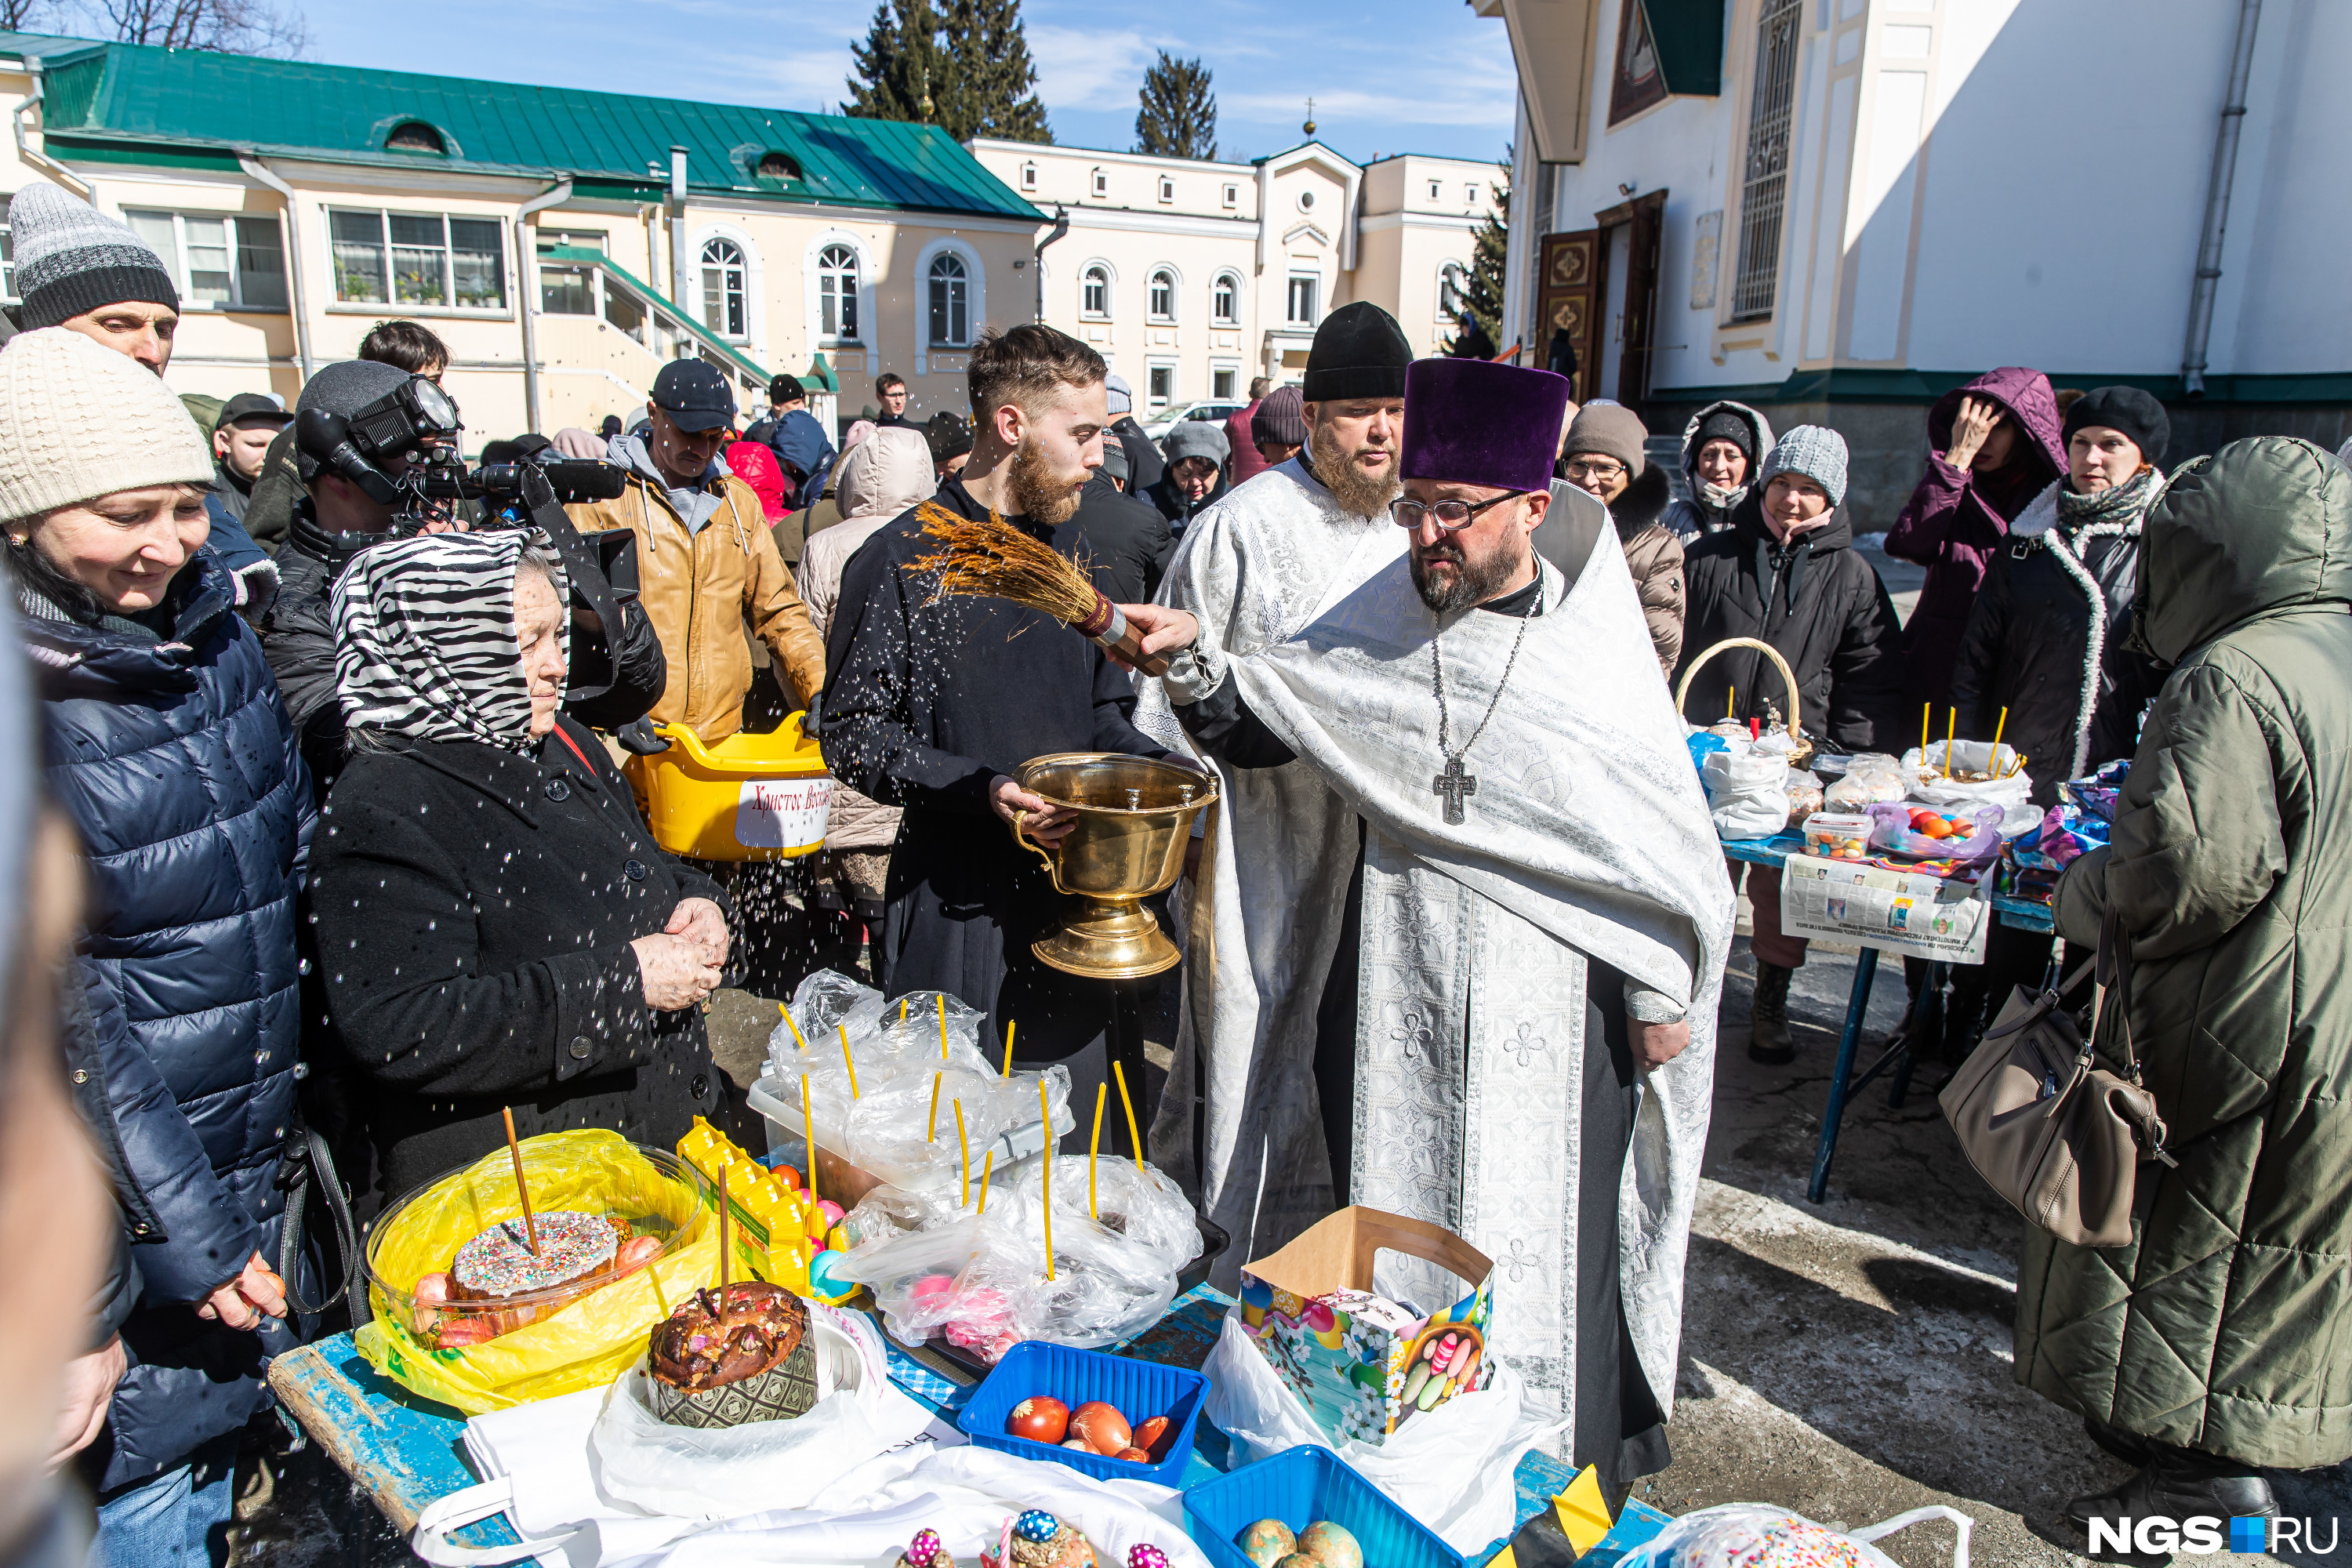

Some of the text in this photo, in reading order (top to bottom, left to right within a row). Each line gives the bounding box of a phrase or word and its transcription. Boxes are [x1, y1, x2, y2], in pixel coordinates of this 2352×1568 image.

[378, 435, 394, 448] SWIT
[752, 785, 802, 819] Христос
[1922, 935, 1961, 944] ИМПОТЕНТА?
